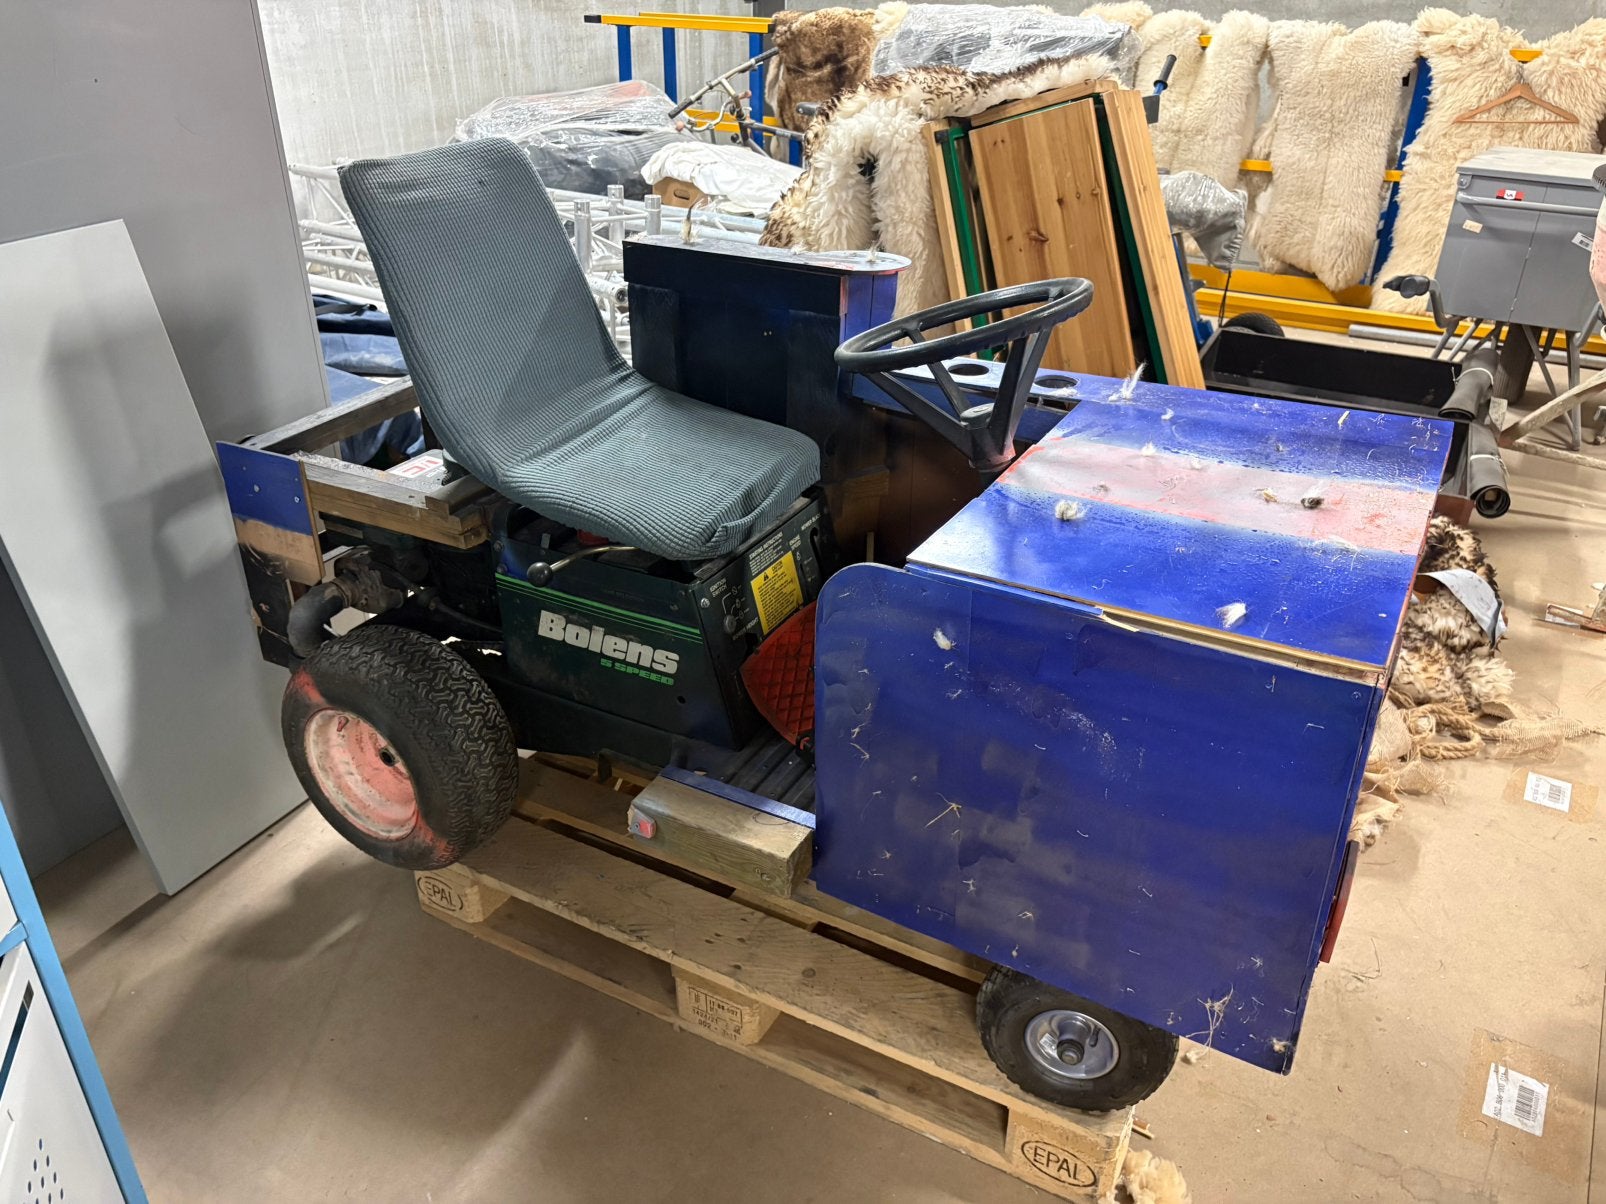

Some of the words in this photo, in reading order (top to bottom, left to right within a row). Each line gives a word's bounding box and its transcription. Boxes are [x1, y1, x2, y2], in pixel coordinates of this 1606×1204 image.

[538, 610, 680, 675] Bolens
[600, 658, 613, 668] 5
[614, 662, 675, 686] SPEED
[425, 880, 457, 907] EPAL
[1033, 1145, 1085, 1183] EPAL
